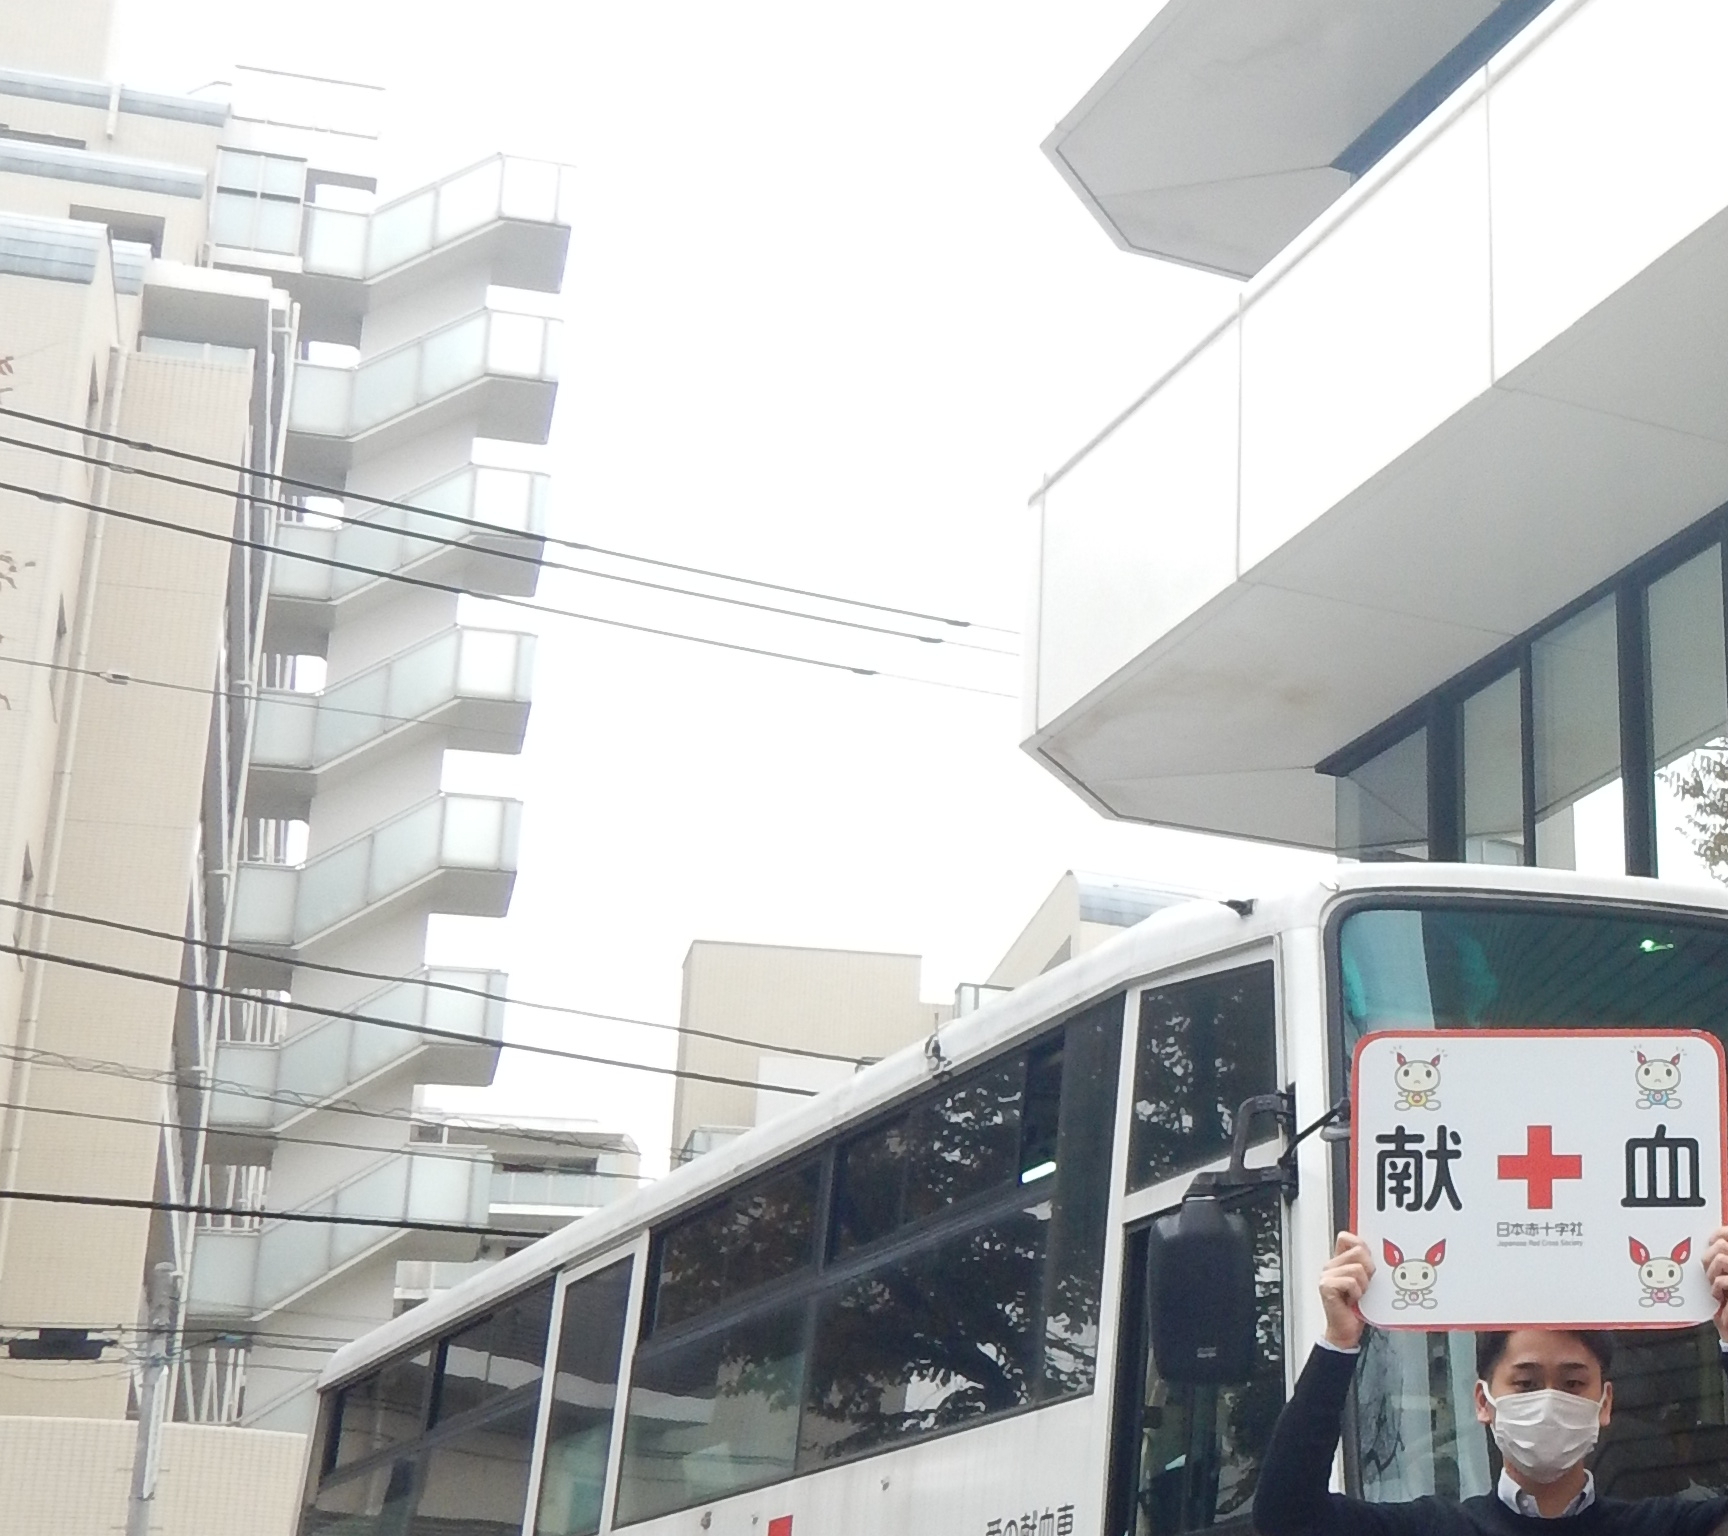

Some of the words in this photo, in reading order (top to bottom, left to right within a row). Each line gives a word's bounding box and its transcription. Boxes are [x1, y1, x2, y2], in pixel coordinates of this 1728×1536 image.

[1375, 1124, 1463, 1212] 献
[1620, 1123, 1706, 1208] 血
[1496, 1221, 1583, 1238] 日本赤十字社
